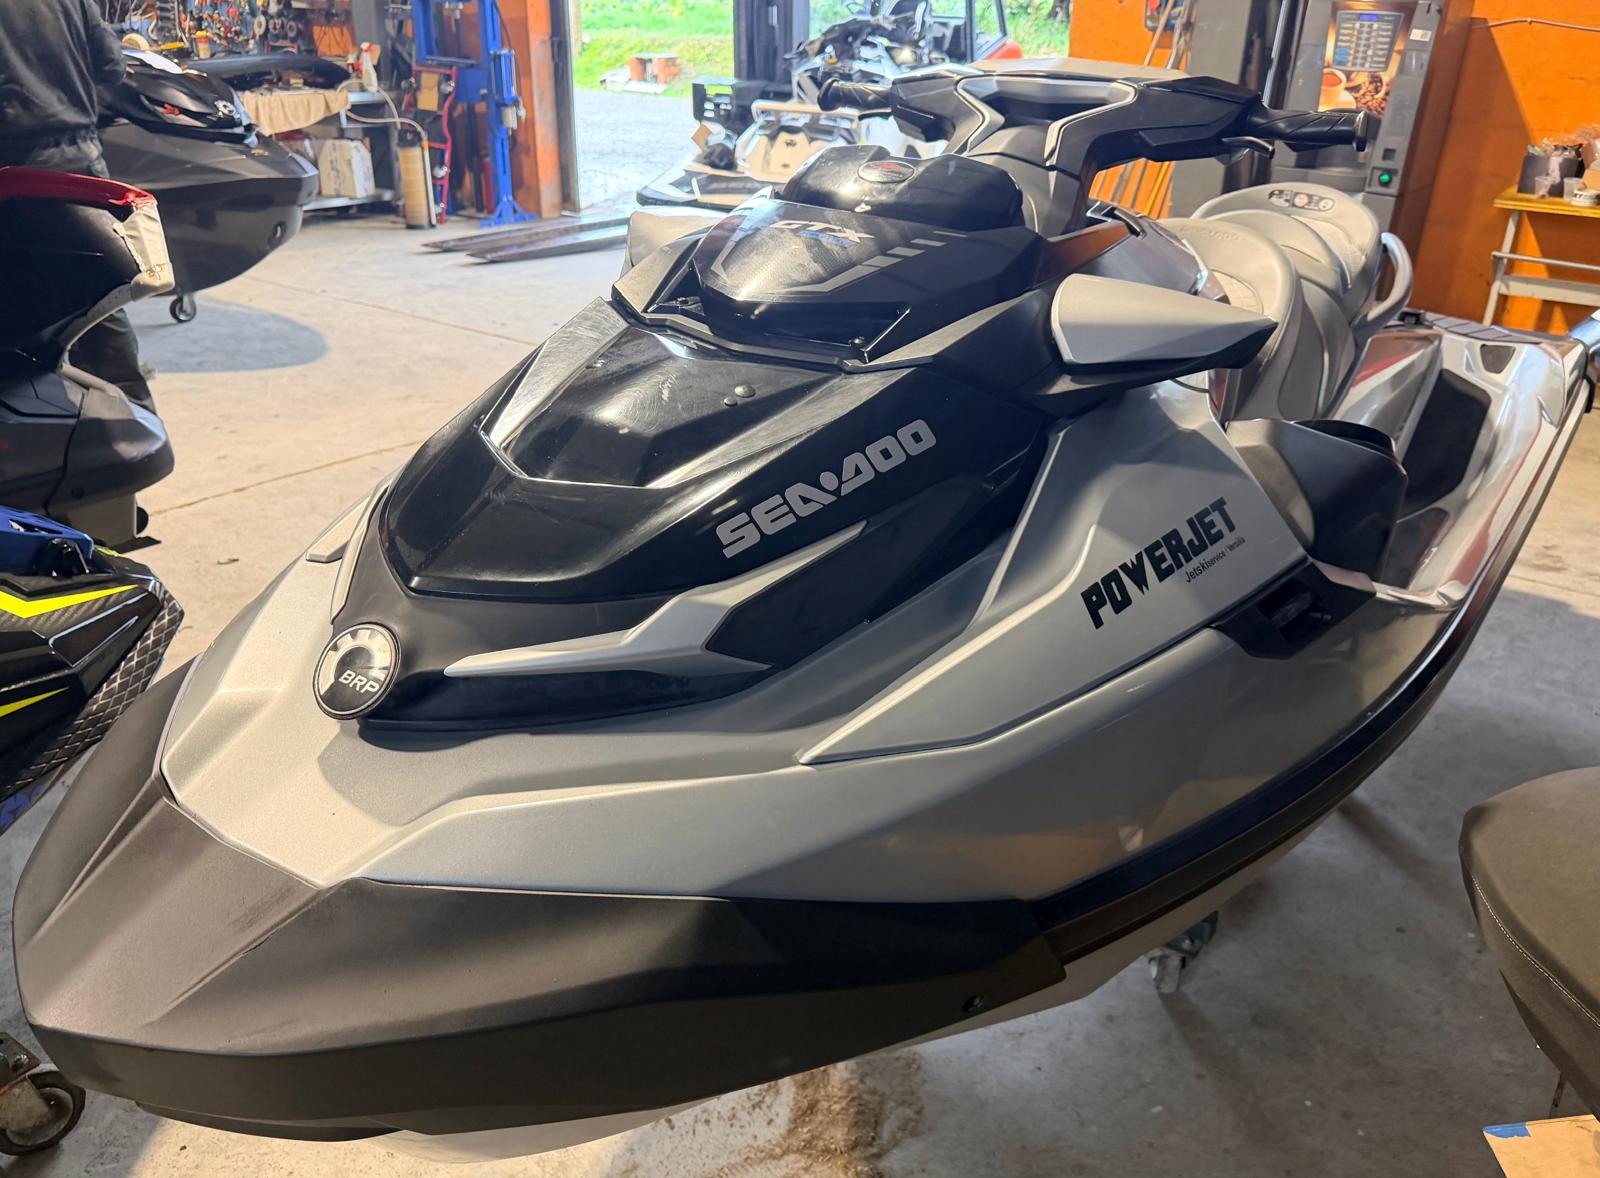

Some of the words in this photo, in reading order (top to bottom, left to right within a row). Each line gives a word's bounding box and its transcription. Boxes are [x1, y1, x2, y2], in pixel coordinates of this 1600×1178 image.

[770, 220, 876, 243] GTX
[1080, 496, 1236, 630] POWERJET
[339, 669, 380, 694] BRP
